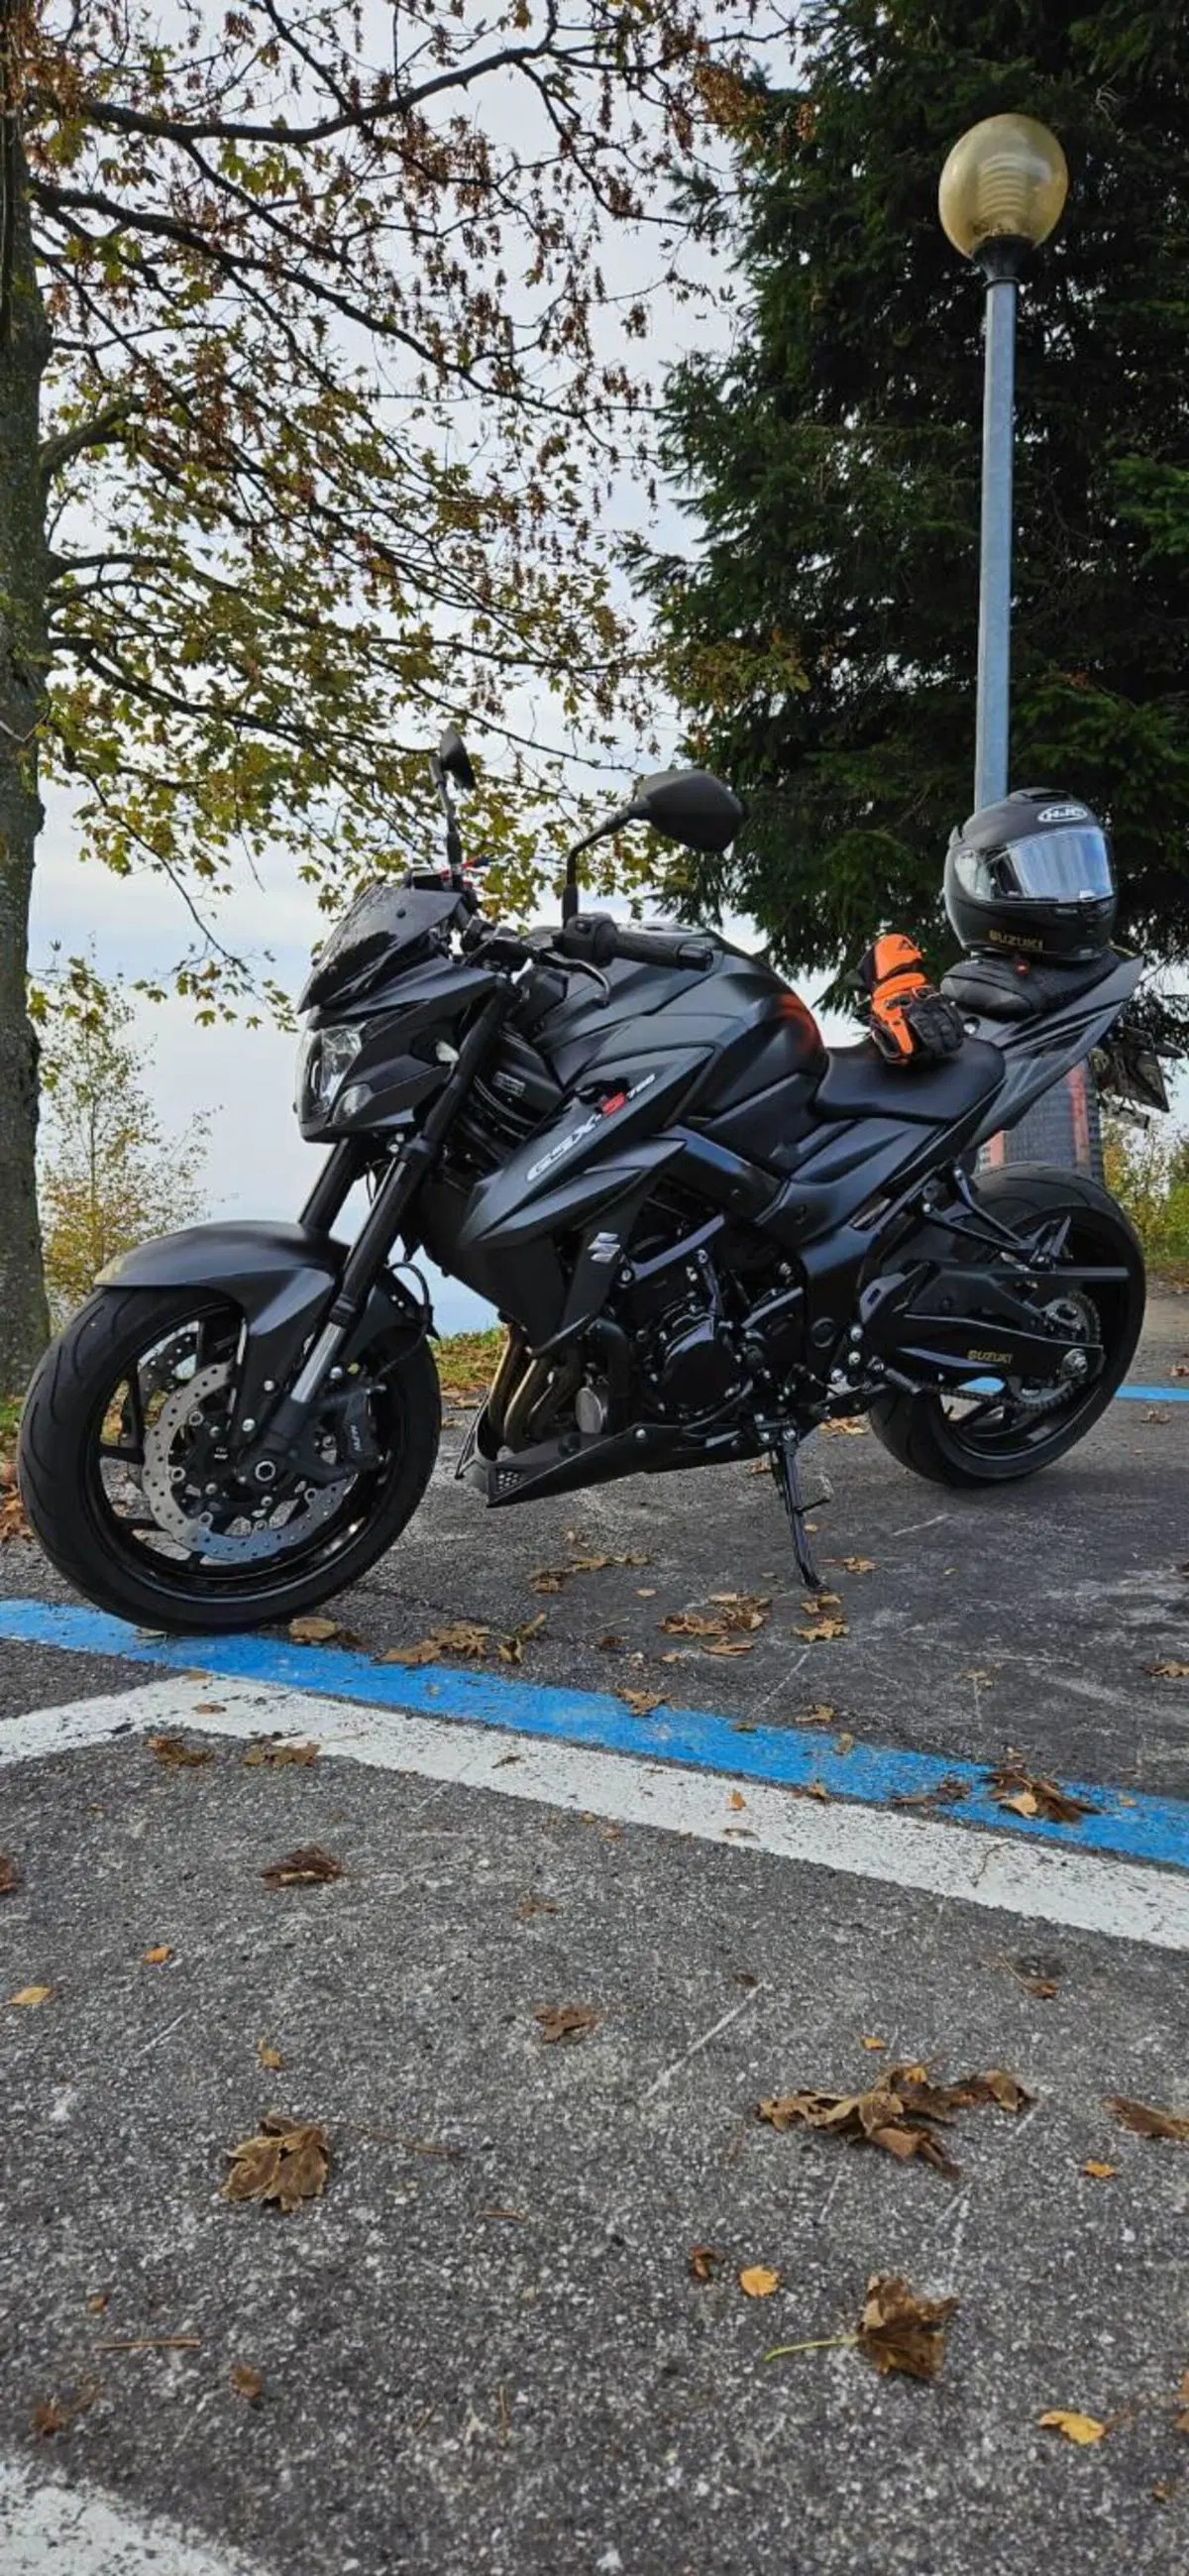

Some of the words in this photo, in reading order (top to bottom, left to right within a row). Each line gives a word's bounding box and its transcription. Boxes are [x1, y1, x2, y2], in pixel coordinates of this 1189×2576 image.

[1043, 805, 1086, 820] HJC
[989, 929, 1043, 951] SUZUKI
[967, 1349, 1013, 1365] SUZUKI
